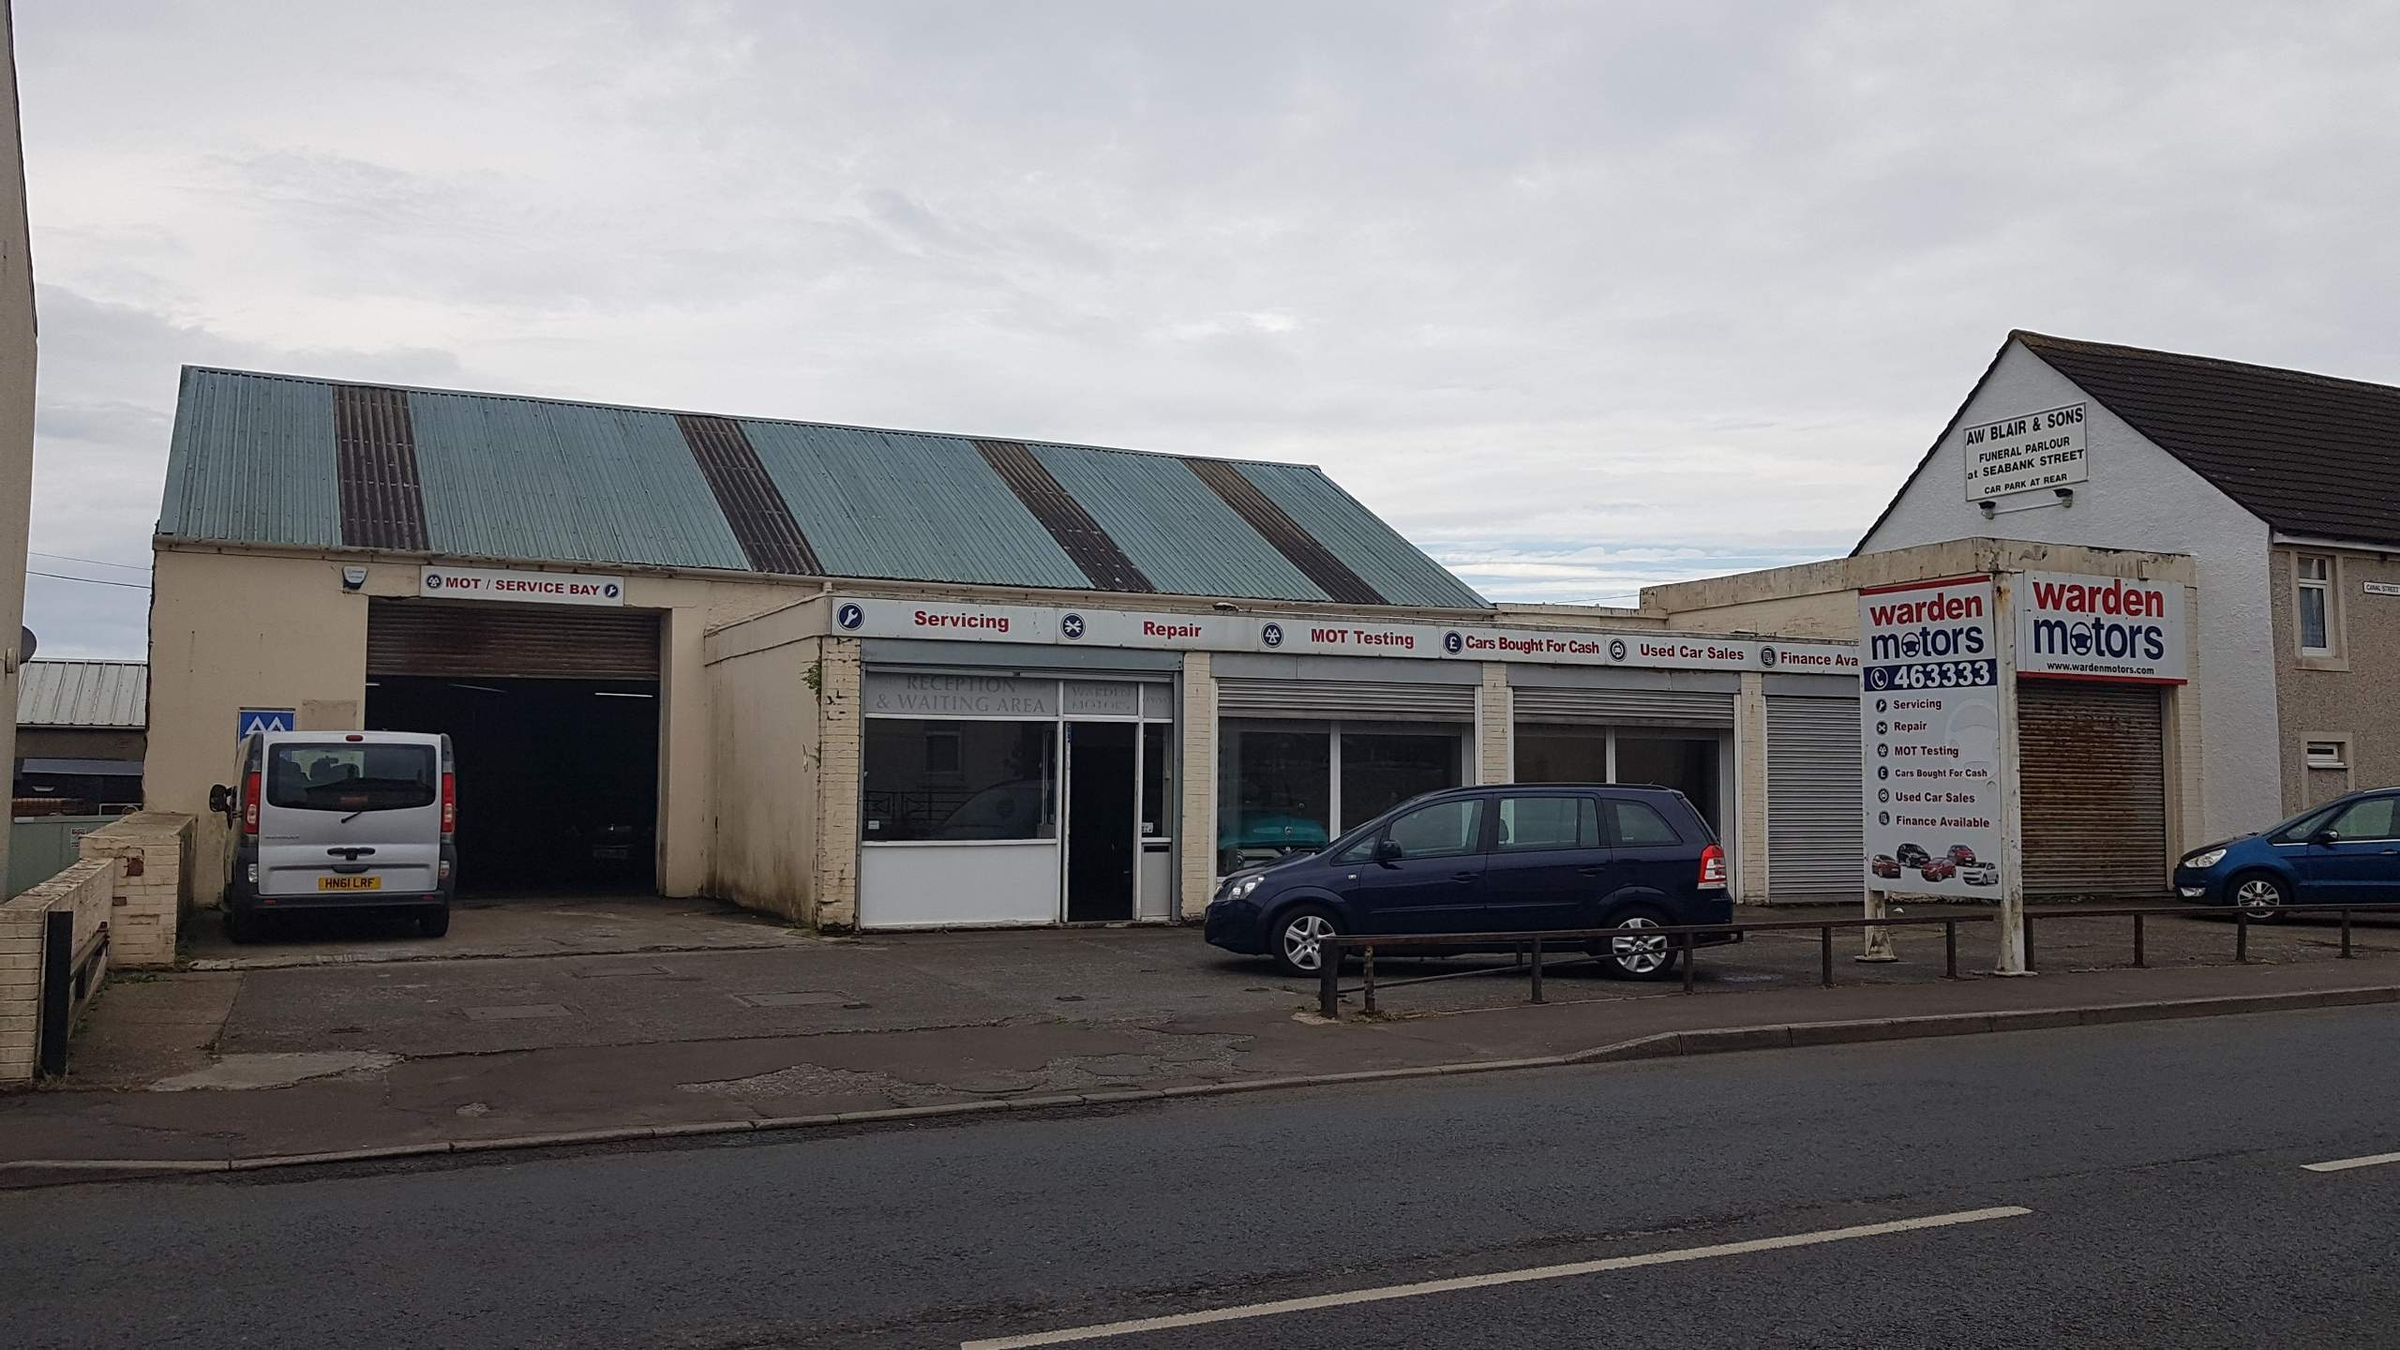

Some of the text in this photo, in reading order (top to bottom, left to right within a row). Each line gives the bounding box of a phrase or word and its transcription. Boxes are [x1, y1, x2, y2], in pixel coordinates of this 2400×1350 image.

[1966, 407, 2084, 446] AW BLAIR & SONS
[1979, 436, 2070, 463] FUNERAL PARLOUR
[1967, 449, 2084, 480] at SEABANK STREET
[1984, 473, 2067, 494] CAR PARK AT REAR
[445, 577, 481, 590] MOT
[495, 580, 564, 594] SERVICE
[569, 584, 600, 596] BAY
[2032, 579, 2164, 618] warden
[1869, 592, 1983, 626] warden
[914, 611, 1009, 633] Servicing
[1143, 621, 1202, 639] Repair
[1311, 628, 1414, 650] MOT Testing
[1465, 635, 1496, 650] Cars
[1499, 637, 1544, 655] Bought
[1546, 639, 1566, 653] For
[1569, 640, 1599, 654] Cash
[1640, 644, 1744, 661] Used Car Sales
[1781, 652, 1859, 667] Finance Ava
[1894, 661, 1990, 688] 463333
[2046, 662, 2155, 675] www.wardenmotors.com
[906, 675, 1016, 693] RECEPTION
[876, 694, 1046, 713] & WAITING AREA
[1893, 699, 1942, 710] Servicing
[1894, 721, 1927, 732] Repair
[1894, 746, 1959, 758] MOT Testing
[1895, 769, 1988, 779] Cars Bought For Cash
[1895, 792, 1976, 803] Used Car Sales
[1896, 816, 1990, 828] Finance Available
[325, 878, 375, 889] HN61 LRF
